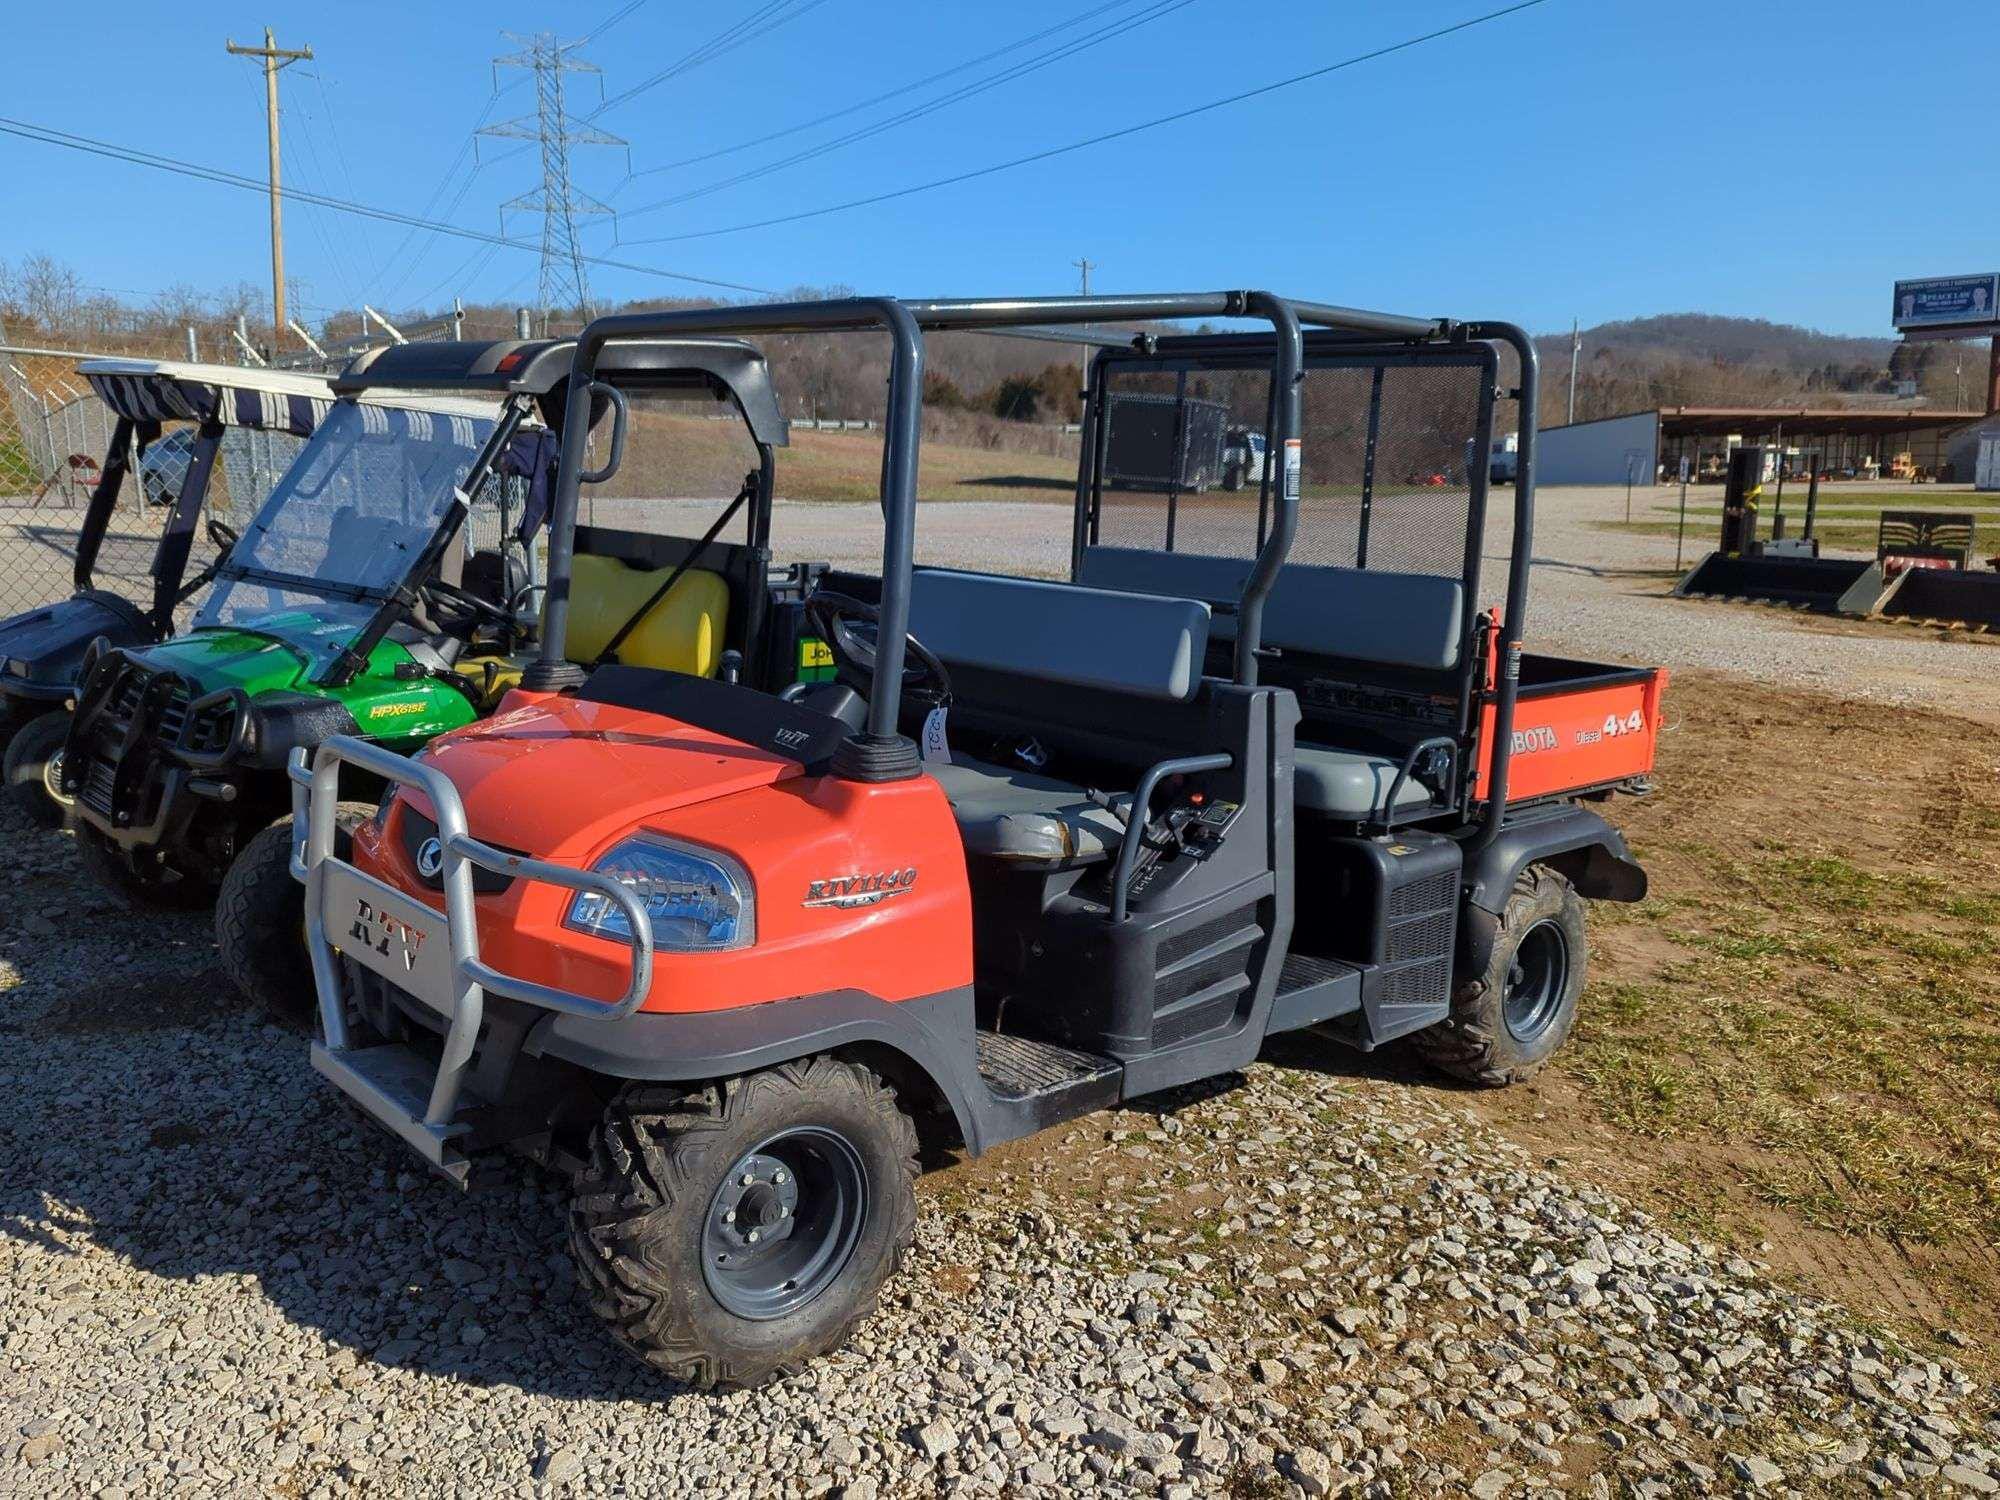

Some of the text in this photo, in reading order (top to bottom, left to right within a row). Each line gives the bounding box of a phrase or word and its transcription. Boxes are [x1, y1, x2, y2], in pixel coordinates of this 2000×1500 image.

[1603, 709, 1642, 737] 4x4
[807, 867, 917, 900] RTV1140
[348, 898, 426, 971] RTV
